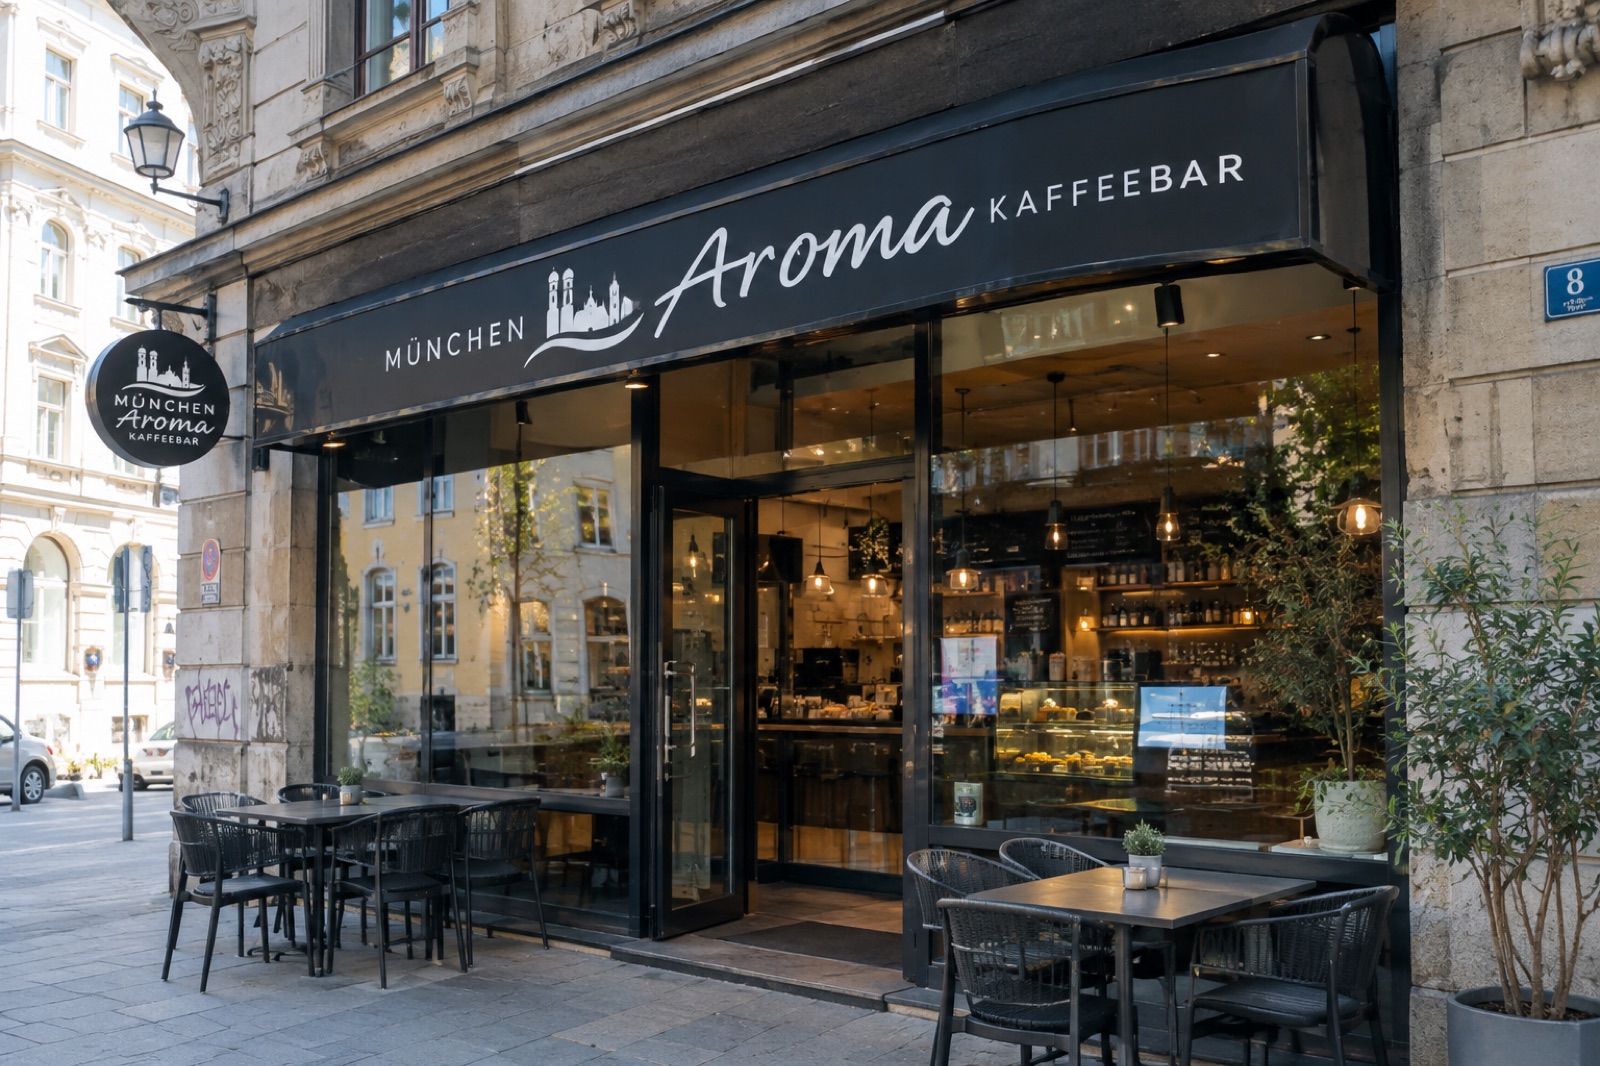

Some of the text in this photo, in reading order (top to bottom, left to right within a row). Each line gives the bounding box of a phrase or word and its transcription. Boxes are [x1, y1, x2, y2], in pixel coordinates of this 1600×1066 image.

[385, 153, 1244, 372] MÜNCHEN Aroma KAFFEEBAR
[1566, 267, 1585, 295] 8
[114, 393, 215, 415] MÜNCHEN
[115, 408, 215, 435] Aroma
[128, 432, 199, 446] KAFFEEBAR
